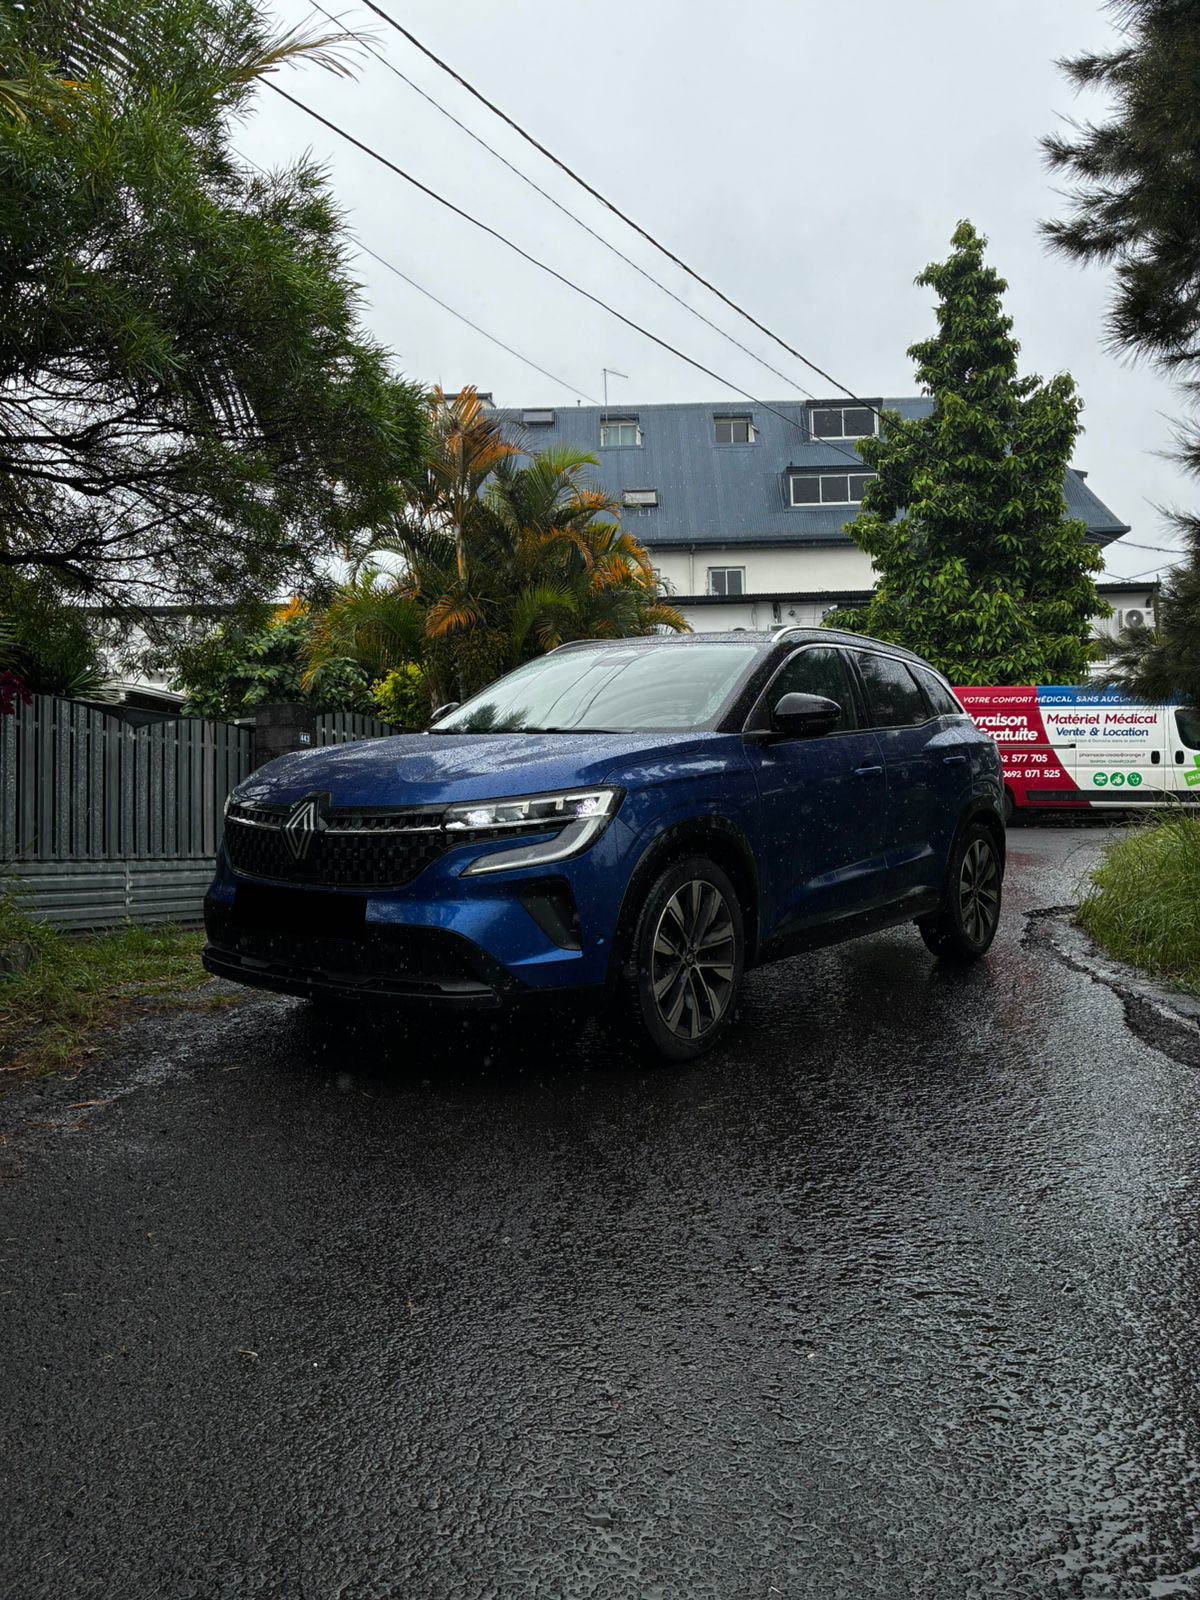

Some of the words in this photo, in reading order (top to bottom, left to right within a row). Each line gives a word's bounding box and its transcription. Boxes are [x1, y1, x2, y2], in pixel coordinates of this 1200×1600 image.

[963, 696, 990, 704] VOTRE
[992, 696, 1033, 704] CONFORT
[1034, 695, 1073, 703] MÉDICAL
[1076, 695, 1099, 703] SANS
[1046, 713, 1100, 724] Matériel
[1104, 713, 1158, 724] Médical
[1056, 727, 1086, 736] Vente
[1089, 727, 1099, 736] &
[1103, 726, 1149, 736] Location
[1011, 754, 1028, 763] 577
[1030, 754, 1048, 763] 705
[1024, 770, 1040, 778] 071
[1043, 770, 1061, 778] 525
